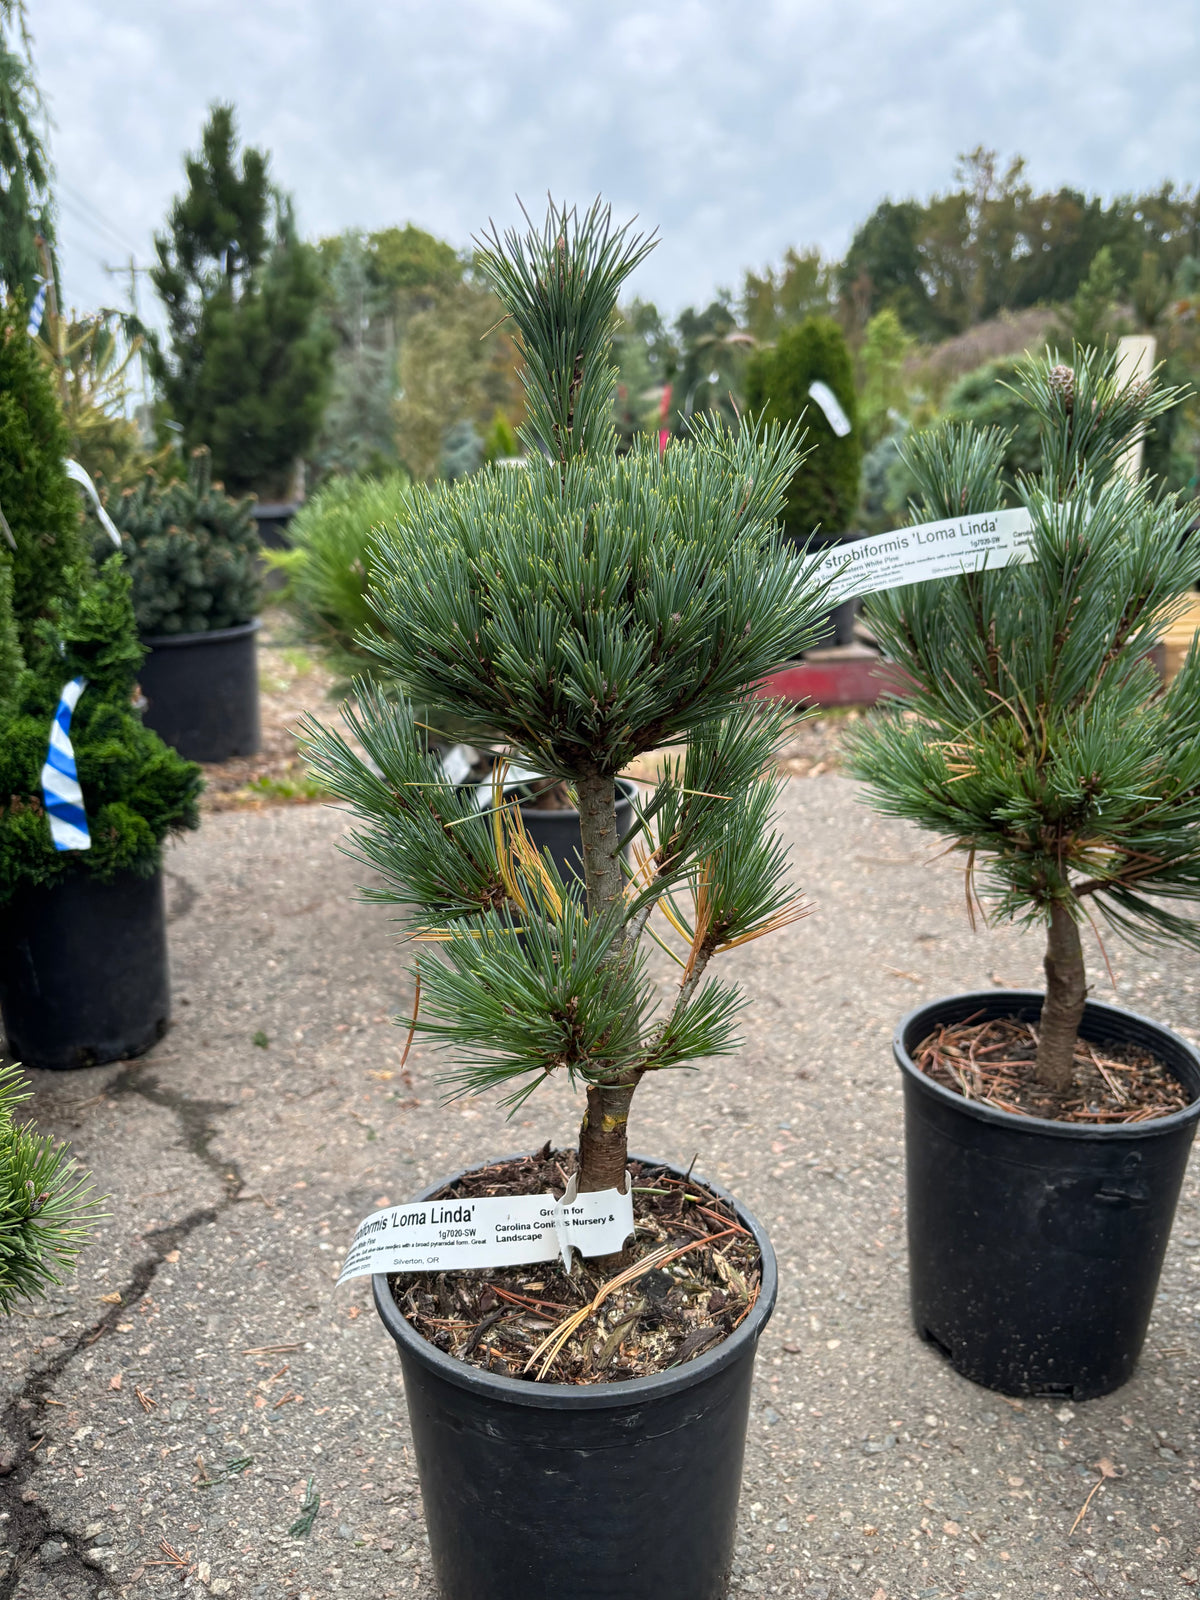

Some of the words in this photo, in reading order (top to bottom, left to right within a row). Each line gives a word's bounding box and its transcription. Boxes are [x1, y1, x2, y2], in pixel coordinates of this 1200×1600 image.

[824, 536, 910, 569] strobiformis
[912, 527, 956, 545] 'Loma
[959, 518, 998, 537] Linda'
[571, 1206, 585, 1215] for
[391, 1212, 426, 1228] 'Loma
[431, 1205, 475, 1224] Linda'
[495, 1222, 531, 1232] Carolina
[572, 1216, 607, 1226] Nursery
[608, 1214, 615, 1222] &
[439, 1229, 477, 1240] 1g7020-SW
[496, 1233, 543, 1243] Landscape
[393, 1257, 424, 1265] Silverton,
[426, 1256, 440, 1264] OR
